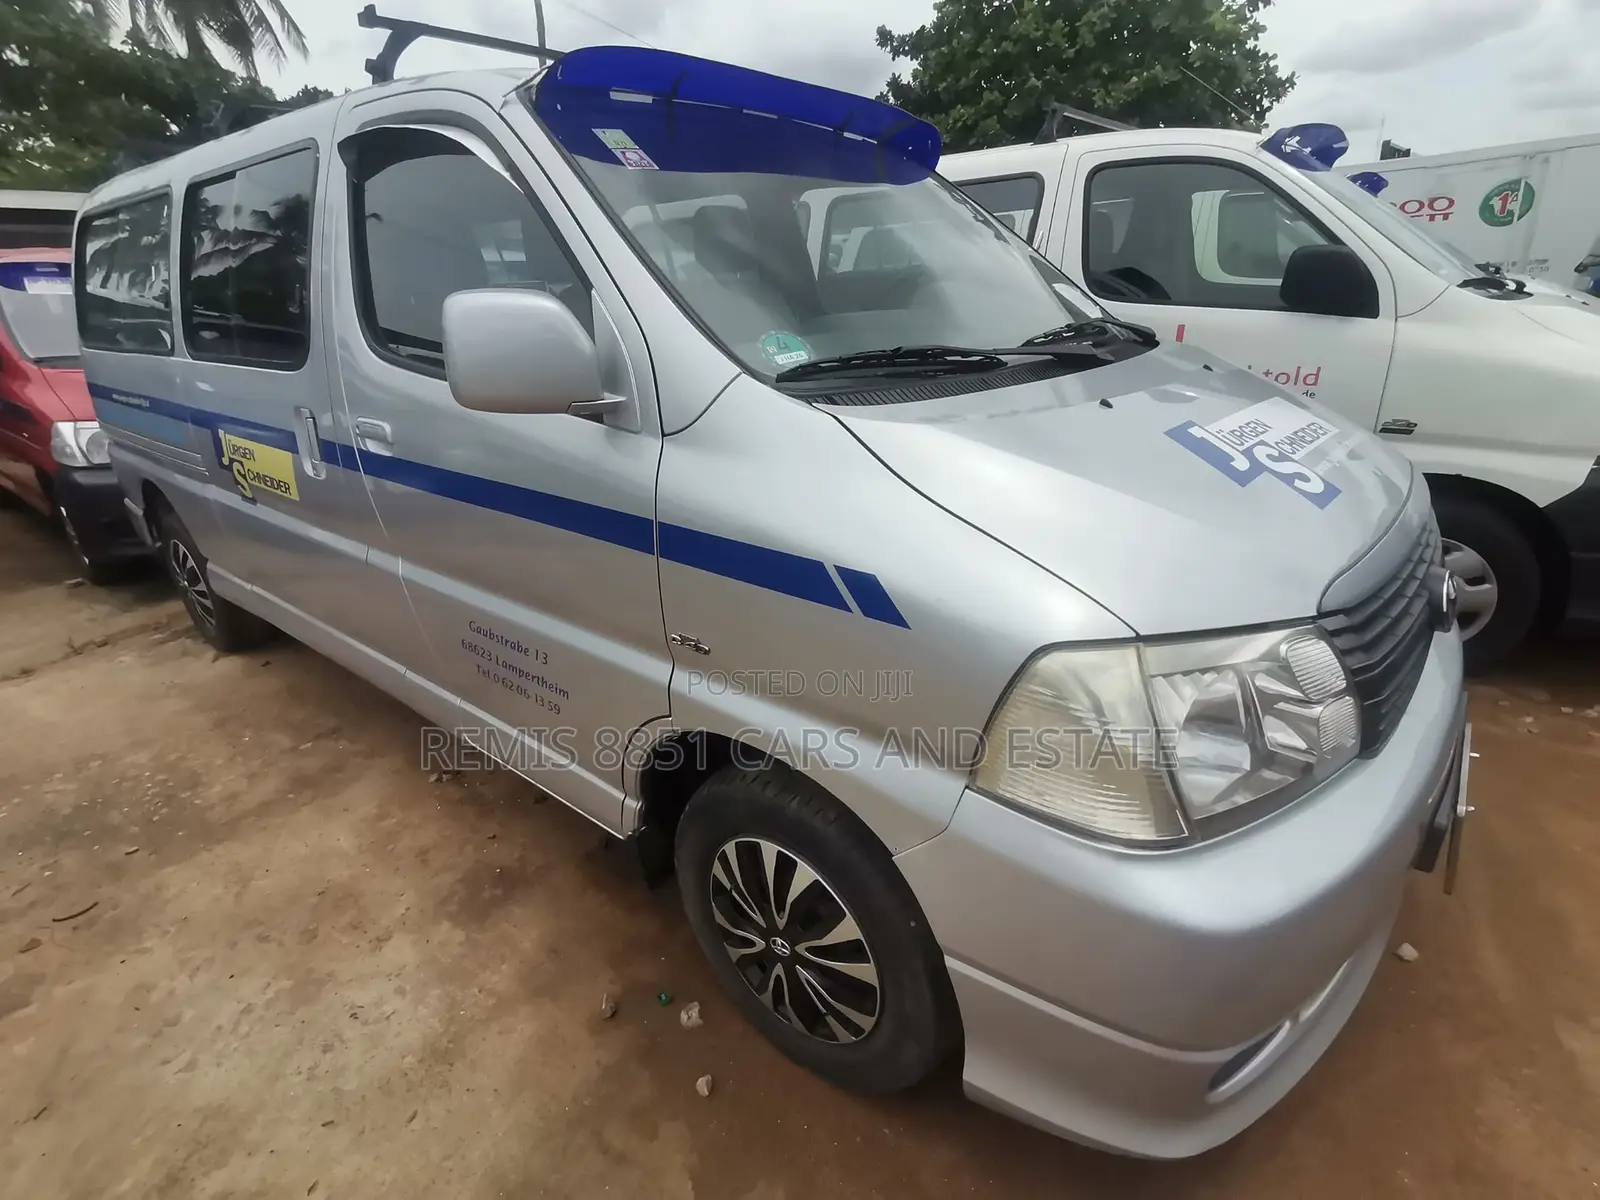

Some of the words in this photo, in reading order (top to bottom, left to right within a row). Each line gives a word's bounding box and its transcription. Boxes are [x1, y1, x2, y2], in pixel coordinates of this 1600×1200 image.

[218, 428, 256, 466] JÜRGEN
[1187, 418, 1274, 471] JÜRGEN
[1253, 422, 1332, 494] SCHNEIDER
[233, 461, 292, 499] SCHNEIDER
[461, 639, 493, 662] 68623
[495, 655, 570, 700] Lampertheim
[535, 648, 549, 665] 13
[535, 693, 545, 707] 13
[548, 700, 561, 715] 59
